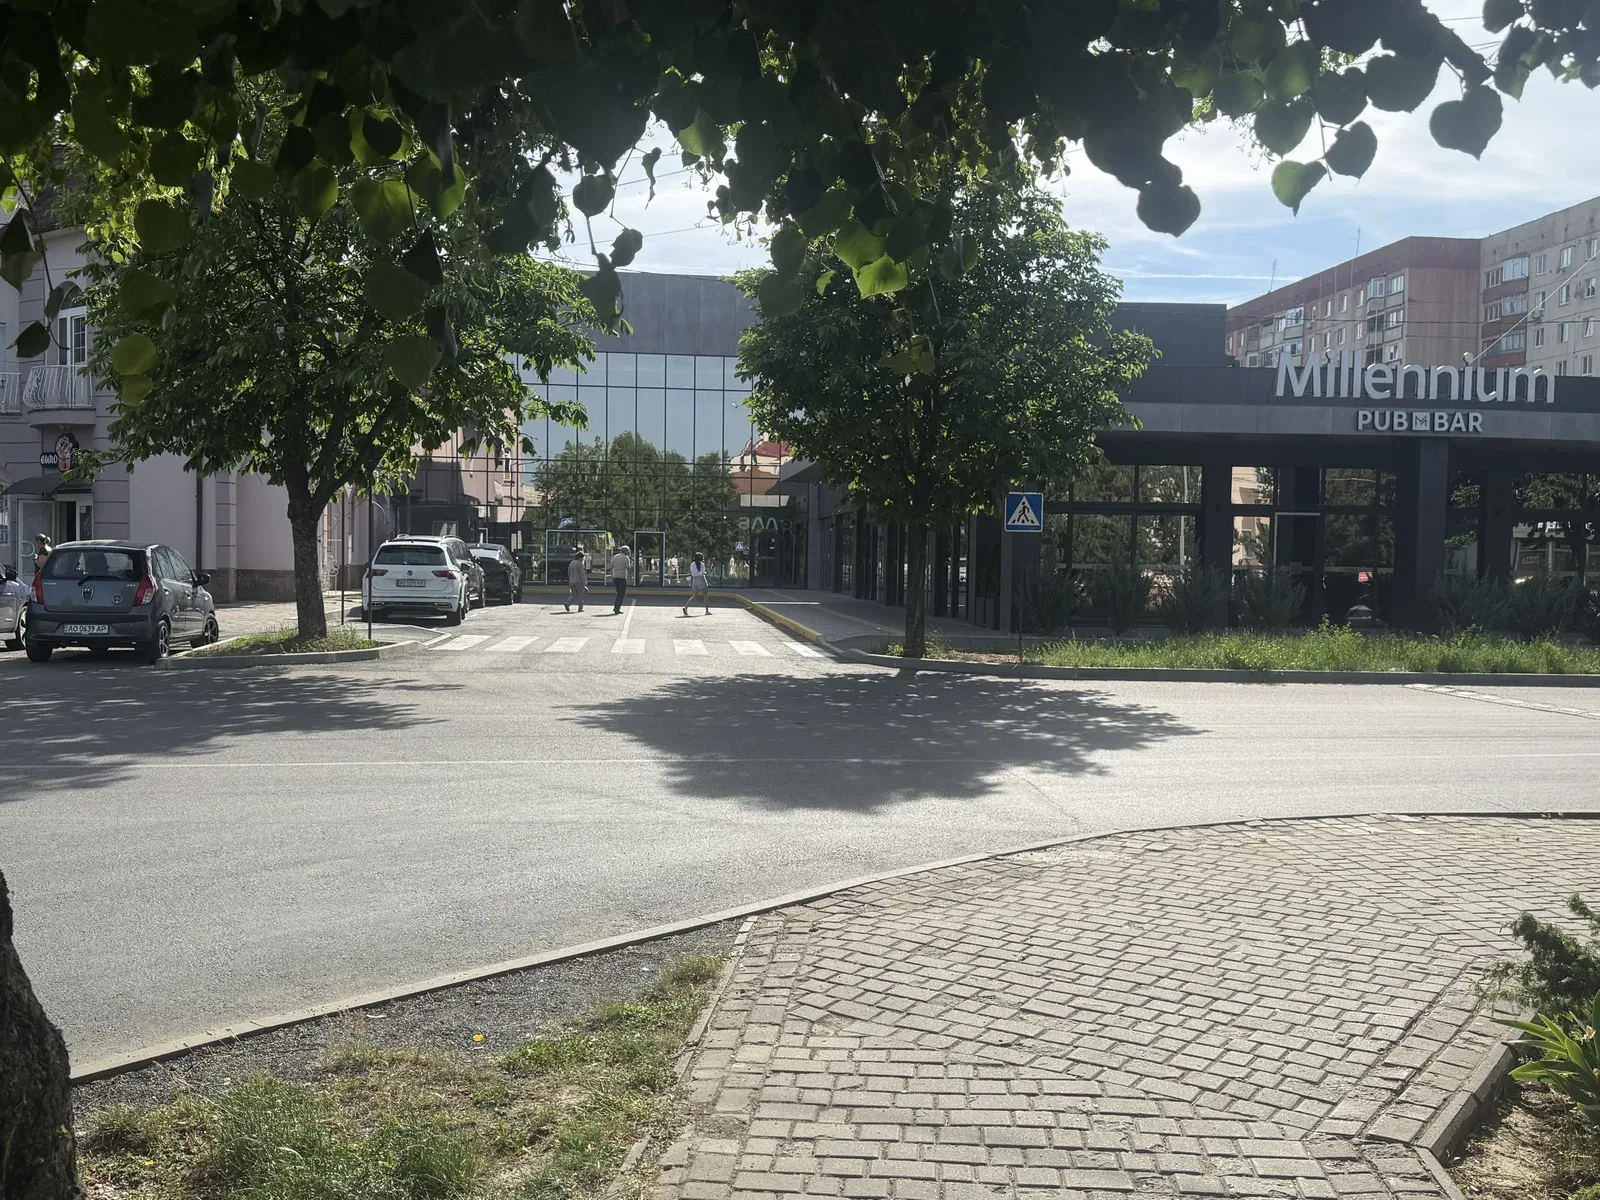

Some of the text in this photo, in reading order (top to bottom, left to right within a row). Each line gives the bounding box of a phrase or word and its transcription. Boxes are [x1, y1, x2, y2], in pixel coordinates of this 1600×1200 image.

[1275, 348, 1555, 403] Millennium
[1357, 410, 1406, 431] PUB
[1433, 412, 1483, 432] BAR
